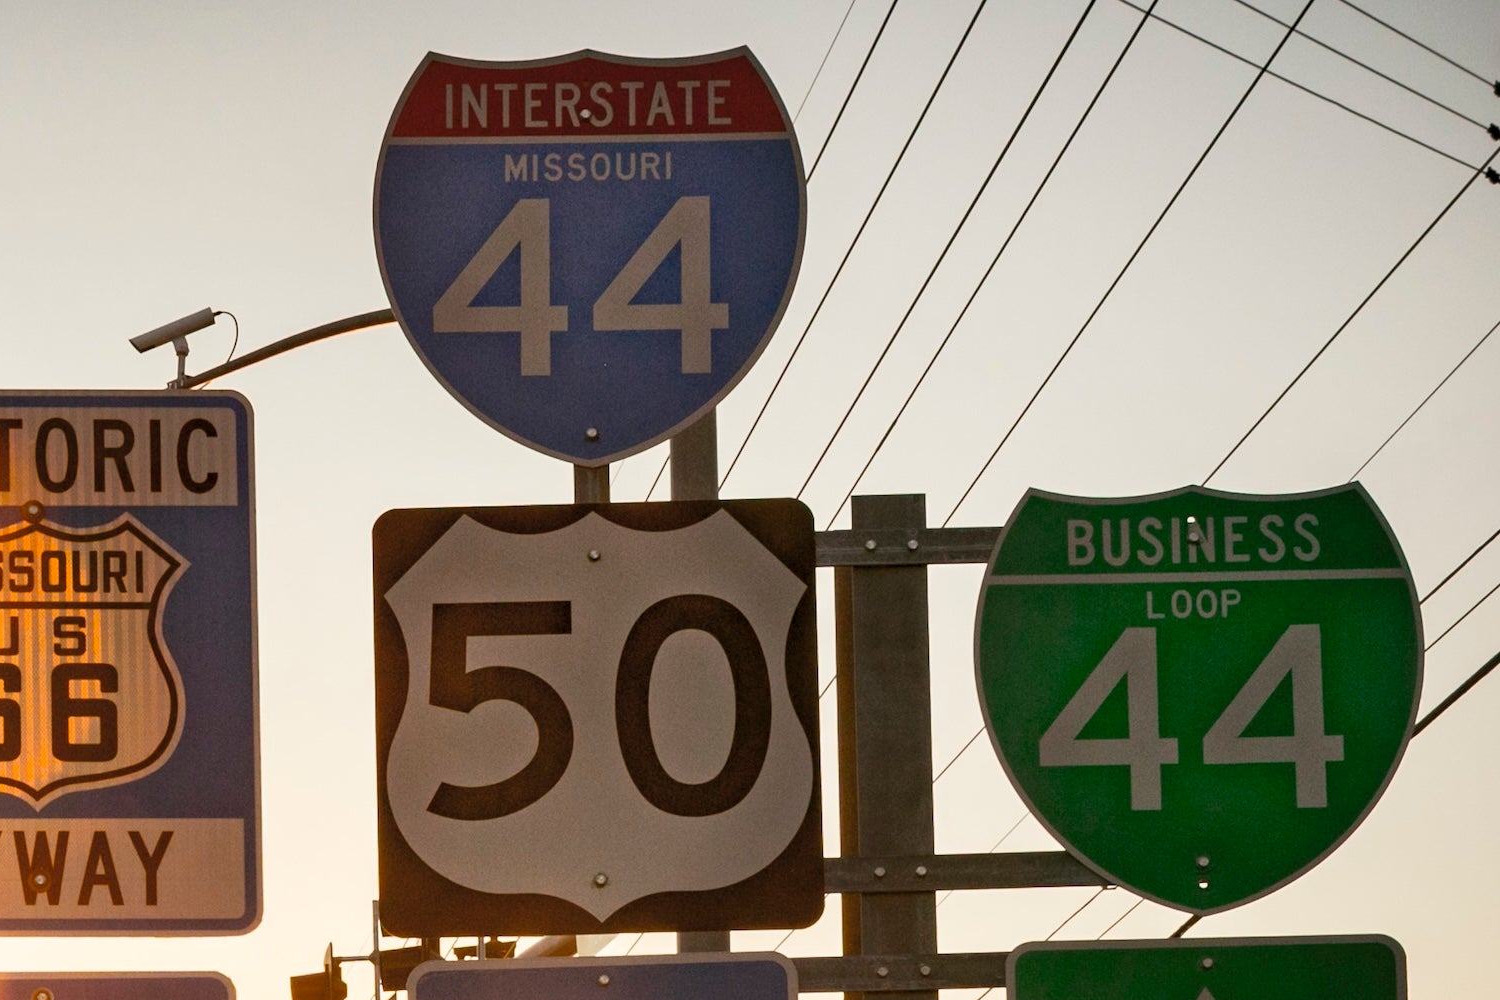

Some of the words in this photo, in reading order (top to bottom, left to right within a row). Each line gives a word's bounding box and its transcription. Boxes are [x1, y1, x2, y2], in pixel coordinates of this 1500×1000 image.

[445, 79, 732, 130] INTERSTATE
[504, 152, 673, 182] MISSOURI
[432, 195, 730, 376] 44
[1067, 513, 1321, 567] BUSINESS
[1146, 589, 1242, 619] LOOP
[53, 616, 87, 656] S
[426, 593, 772, 821] 50
[1039, 623, 1344, 811] 44
